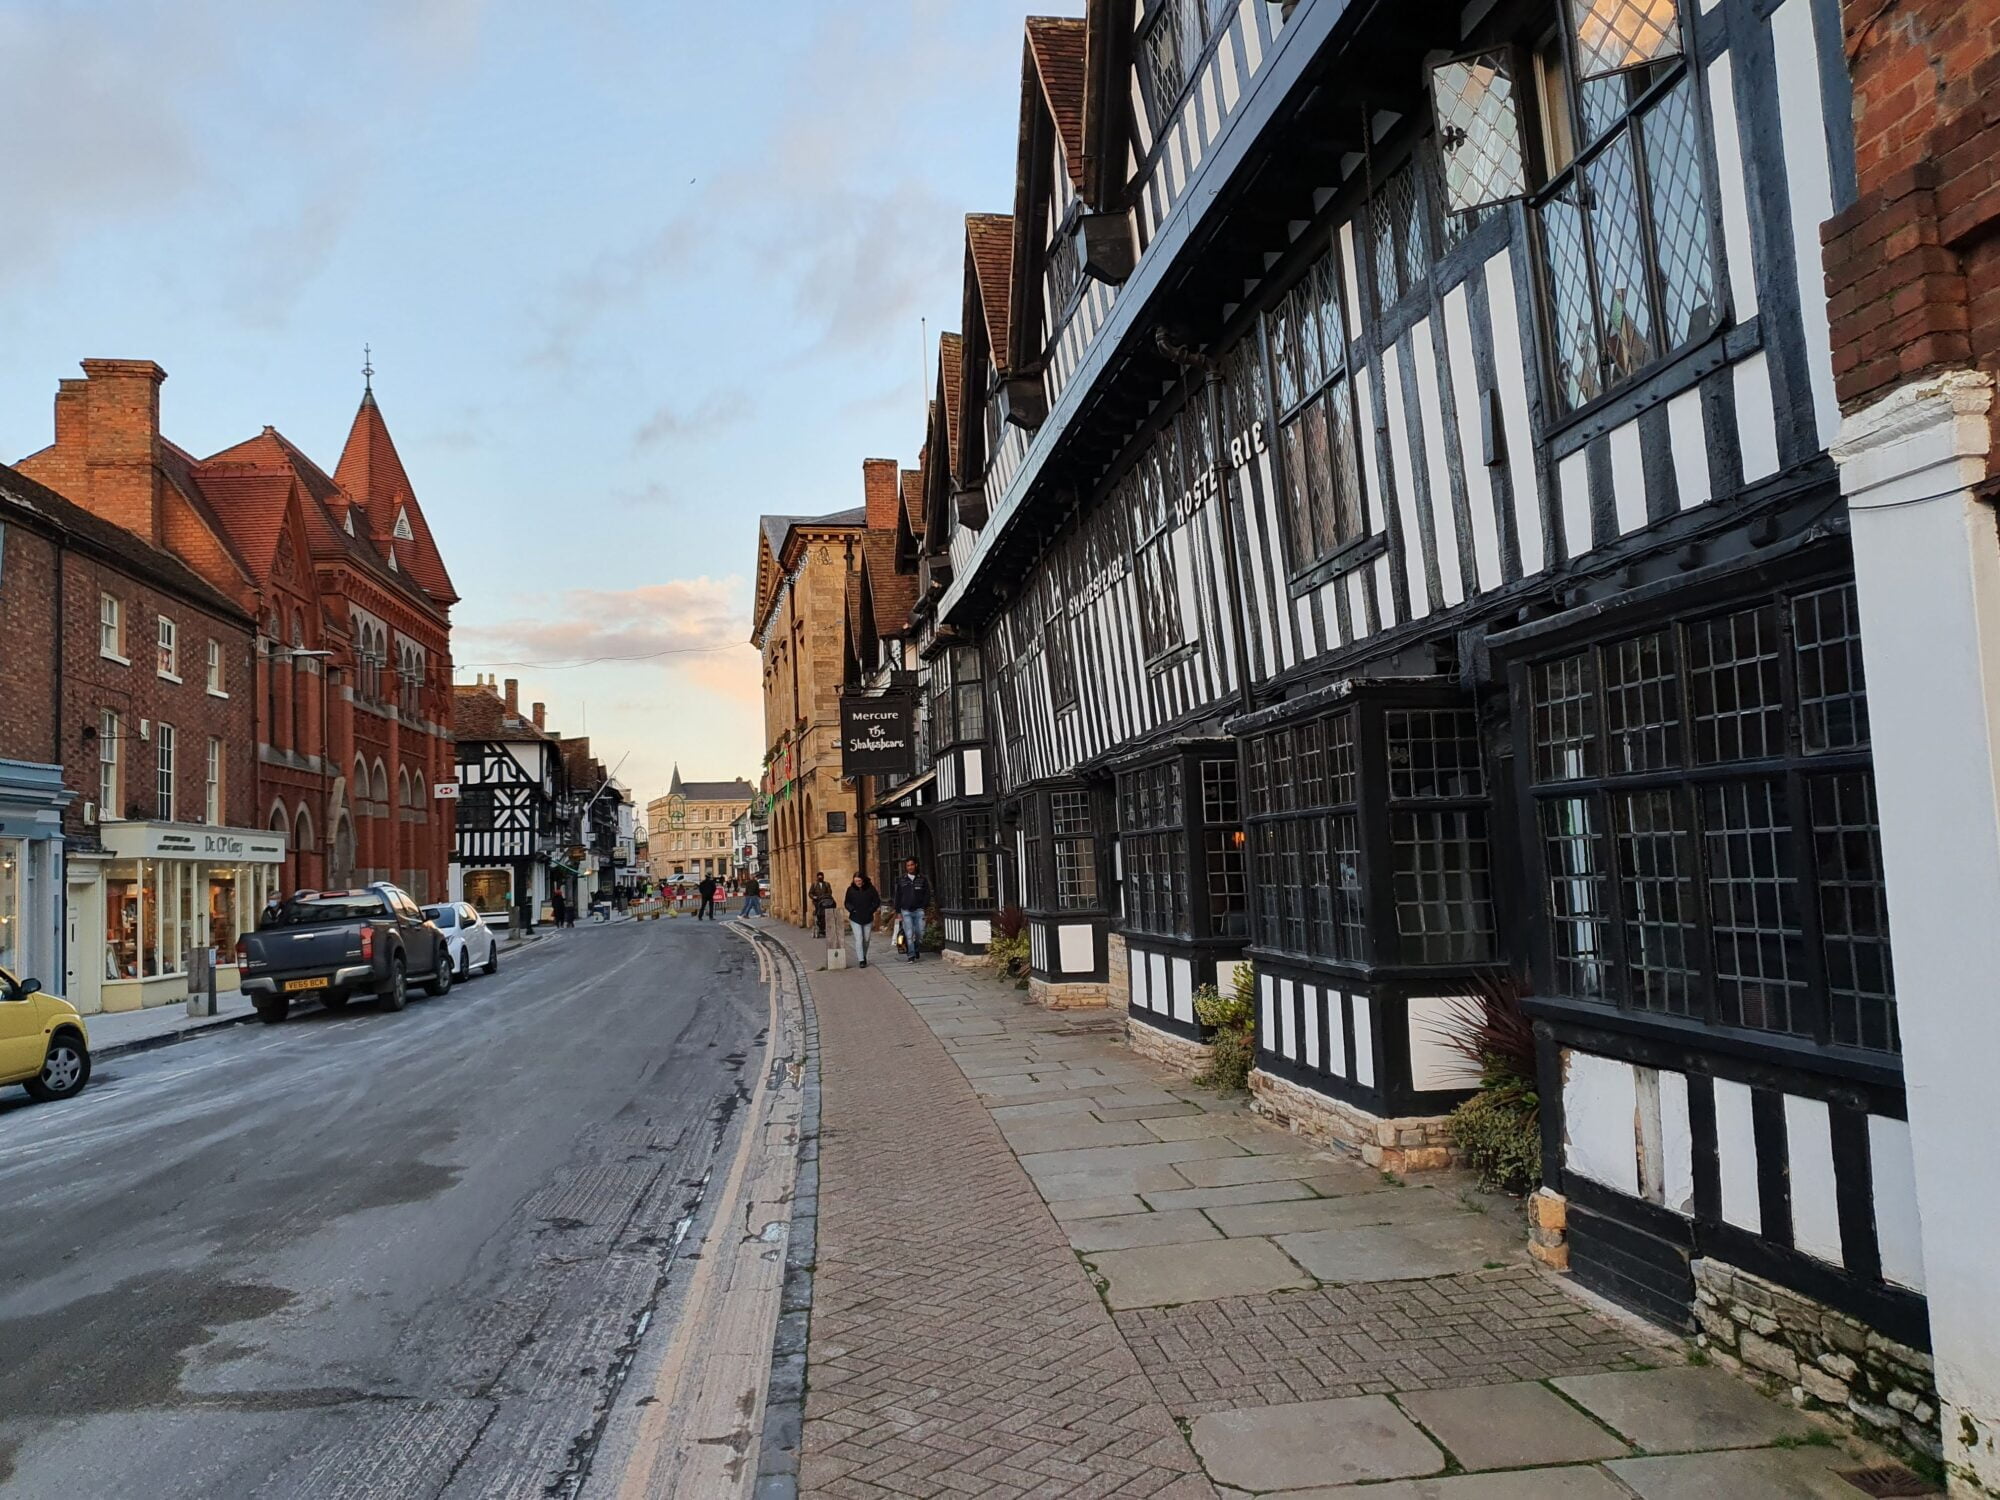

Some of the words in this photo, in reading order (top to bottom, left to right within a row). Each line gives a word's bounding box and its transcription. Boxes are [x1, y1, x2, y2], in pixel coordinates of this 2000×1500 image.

[852, 712, 899, 720] Mercure
[867, 724, 886, 737] The
[850, 738, 904, 752] Shakespeare
